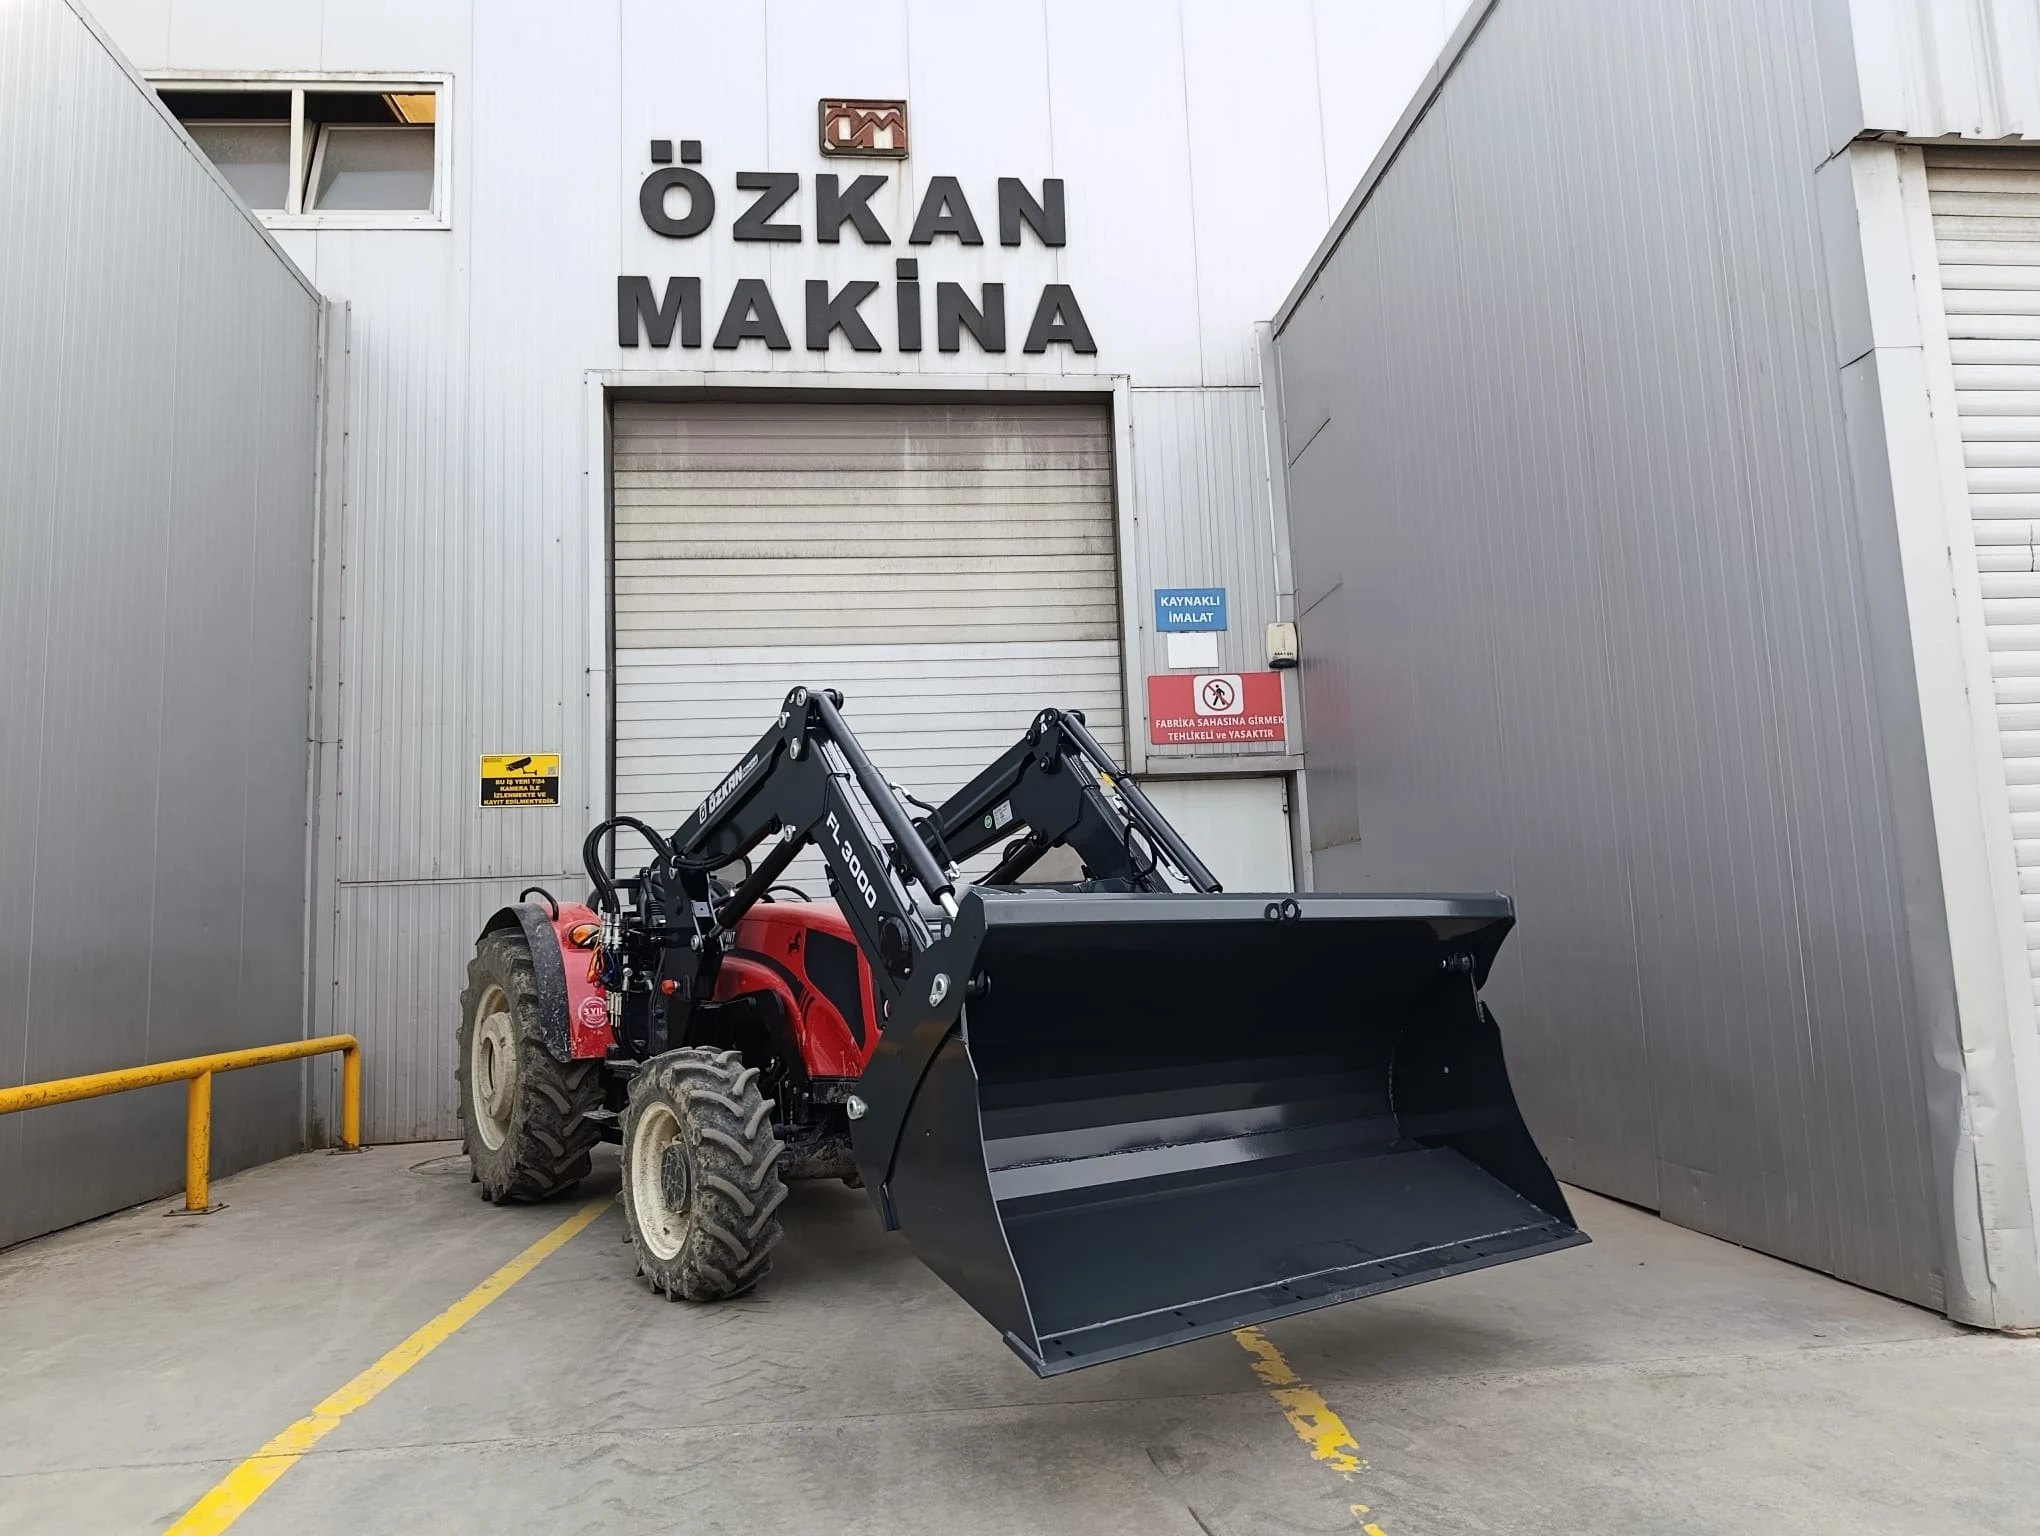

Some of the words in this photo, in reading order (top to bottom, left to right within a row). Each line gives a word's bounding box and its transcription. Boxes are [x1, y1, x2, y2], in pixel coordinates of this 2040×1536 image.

[639, 139, 1067, 247] ÖZKAN
[617, 257, 1098, 355] MAKİNA
[1160, 596, 1220, 607] KAYNAKLI
[1169, 611, 1214, 623] İMALAT
[1155, 717, 1195, 728] FABRİKA
[1197, 717, 1246, 727] SAHASINA
[1248, 715, 1285, 725] GİRMEK
[1168, 730, 1214, 741] TEHLİKELİ
[1228, 729, 1274, 739] YASAKTIR
[708, 765, 743, 814] ÖZKAN
[826, 811, 840, 846] FL
[841, 840, 877, 909] 3000
